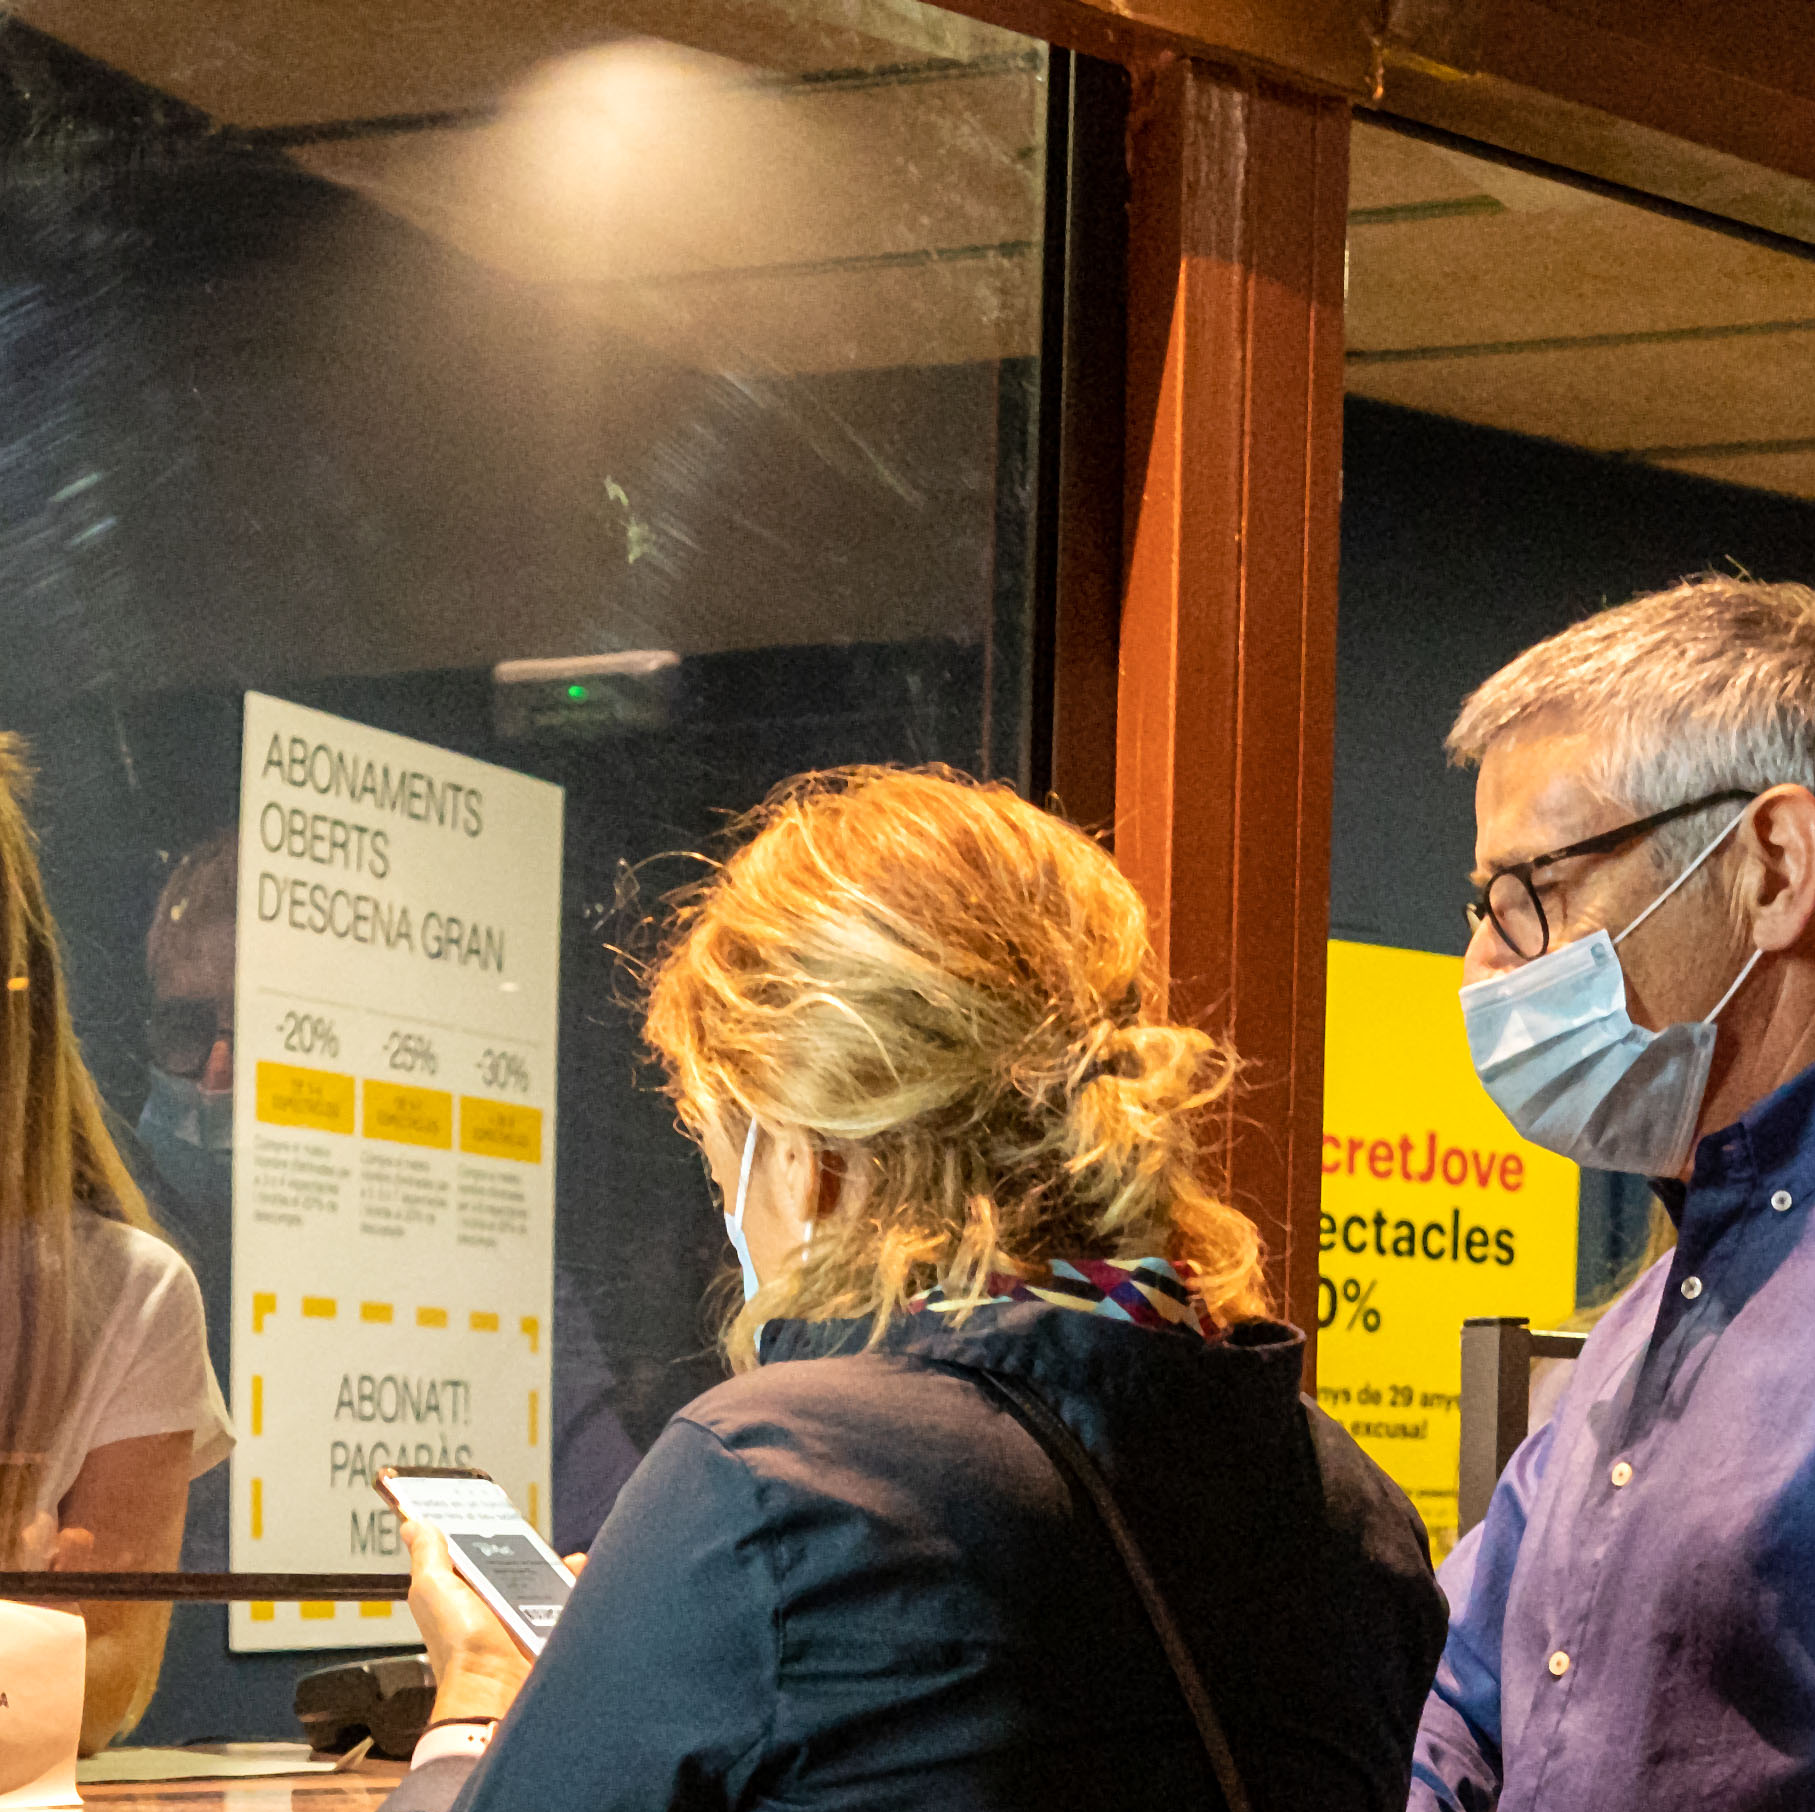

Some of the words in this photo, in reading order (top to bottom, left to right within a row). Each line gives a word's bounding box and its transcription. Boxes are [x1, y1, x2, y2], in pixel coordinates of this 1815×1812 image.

[262, 733, 483, 838] ABONAMENTS
[259, 801, 390, 879] OBERTS
[420, 910, 505, 973] GRAN
[276, 1010, 339, 1059] -20%
[1322, 1131, 1524, 1192] cretJove
[1318, 1208, 1516, 1266] ectacles
[1318, 1276, 1382, 1333] 0%
